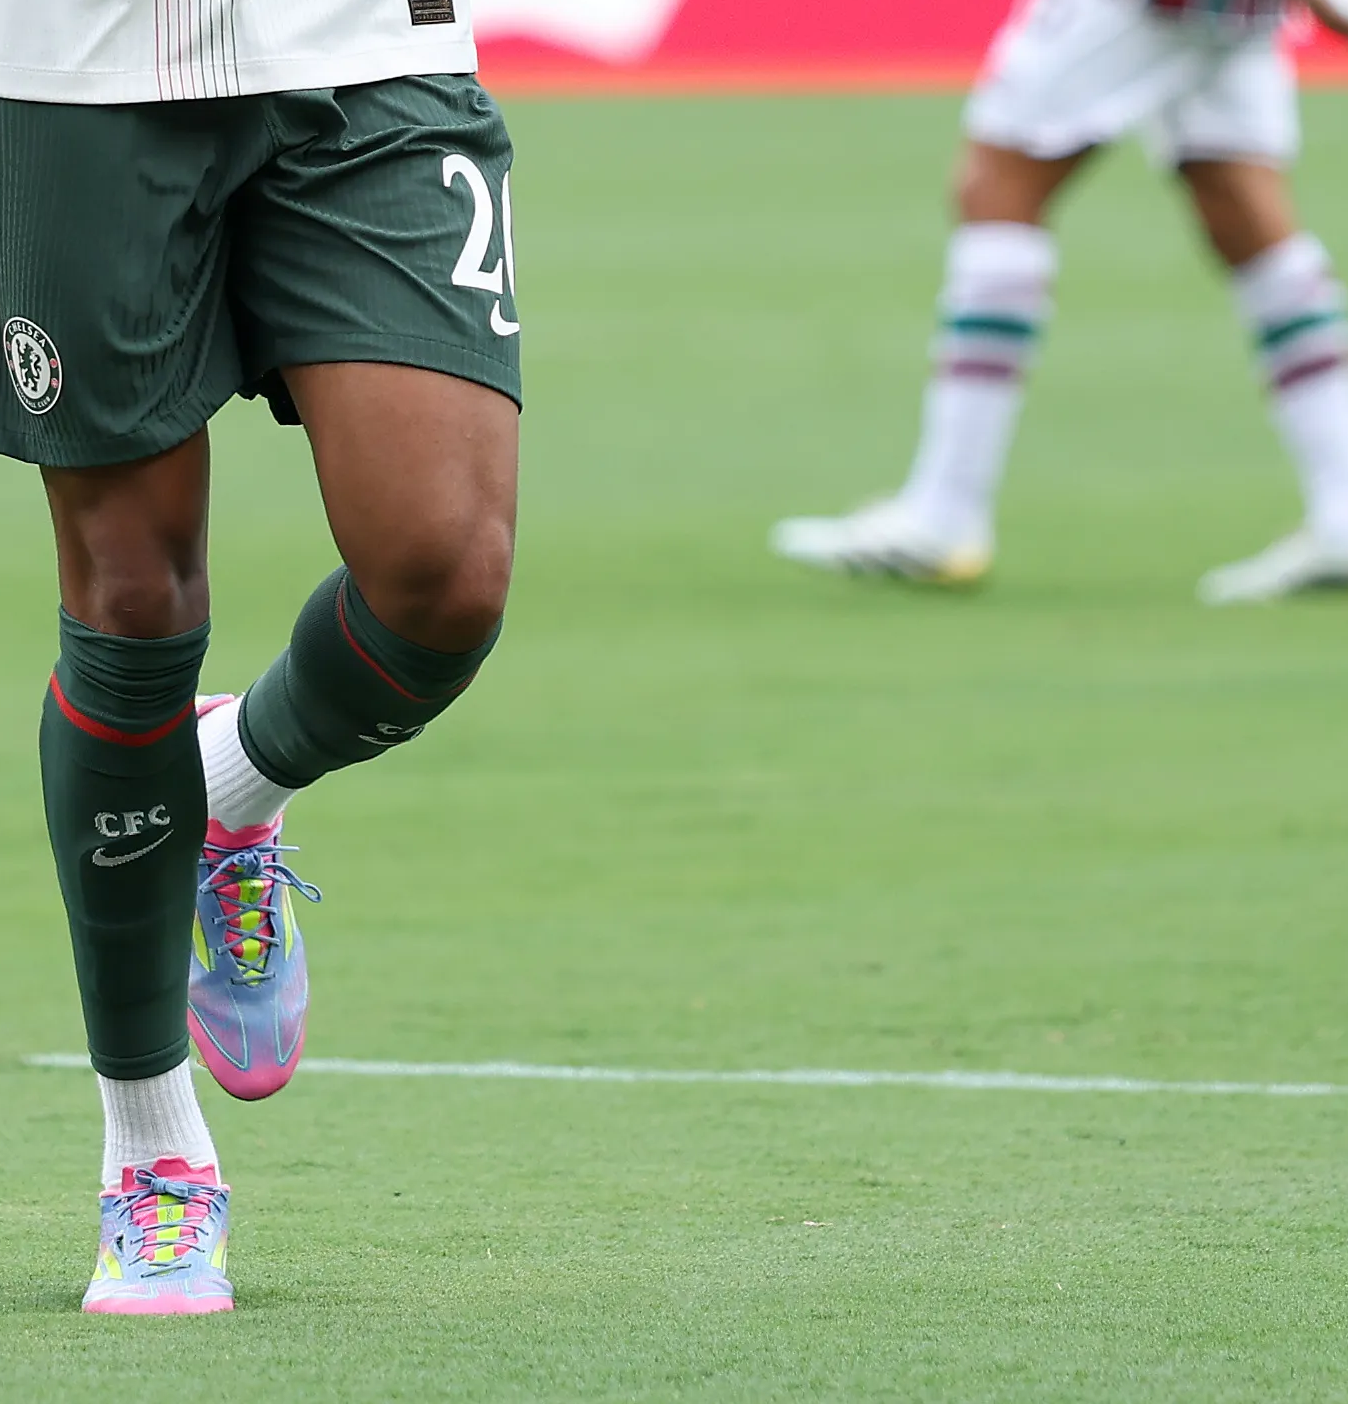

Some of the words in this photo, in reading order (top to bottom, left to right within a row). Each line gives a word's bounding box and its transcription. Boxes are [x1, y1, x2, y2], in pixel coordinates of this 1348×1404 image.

[442, 153, 515, 296] 2
[8, 321, 47, 347] CHELSEA
[94, 804, 171, 837] CFC
